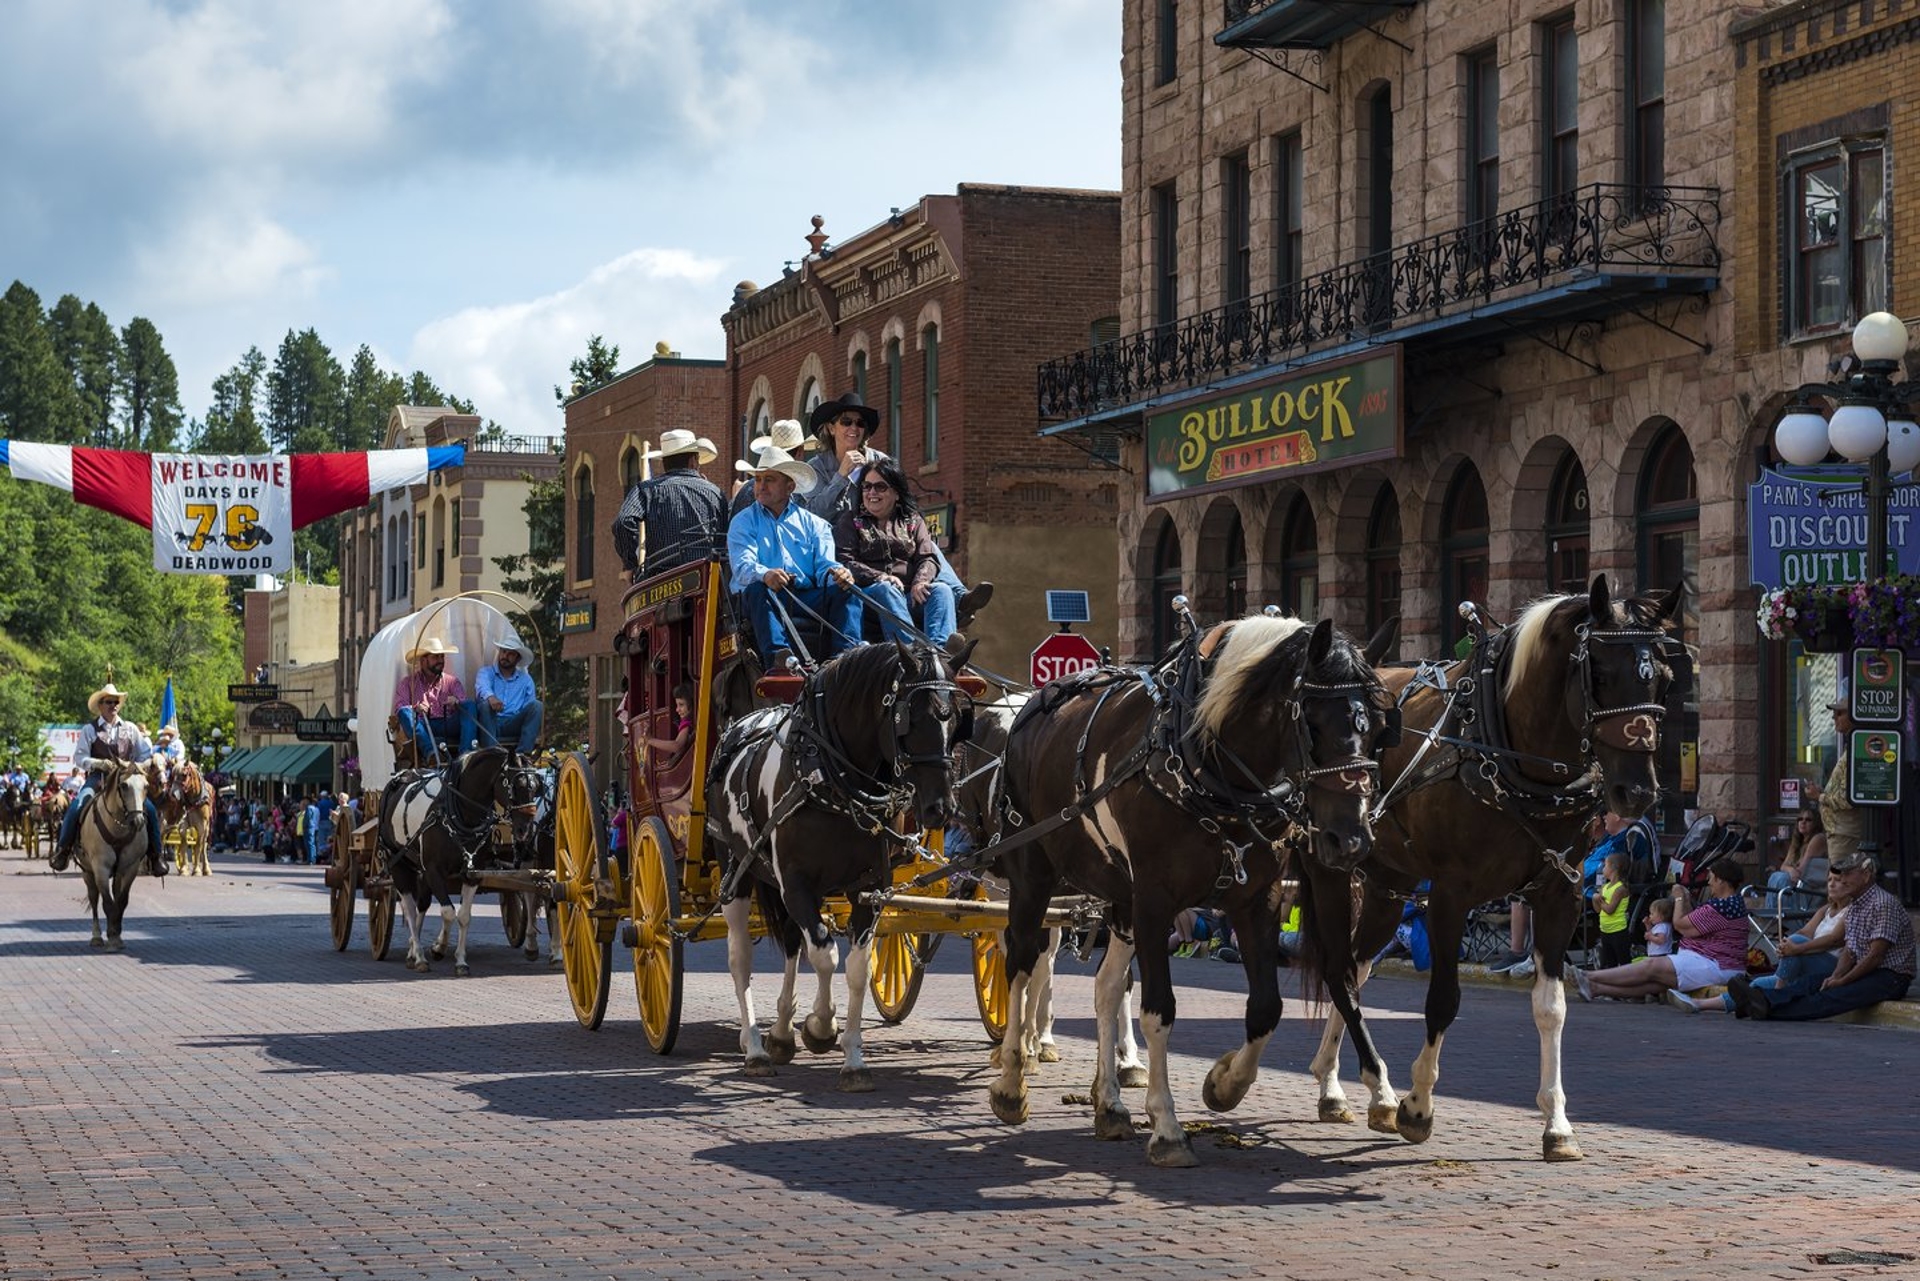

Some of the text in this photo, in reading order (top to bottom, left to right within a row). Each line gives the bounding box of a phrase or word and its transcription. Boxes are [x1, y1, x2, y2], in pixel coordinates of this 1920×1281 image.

[1359, 389, 1388, 416] 1895
[1178, 376, 1356, 473] BULLOCK
[1223, 441, 1298, 471] HOTEL
[160, 461, 285, 488] WELCOME
[184, 486, 259, 499] DAYS OF
[1574, 489, 1587, 511] 6
[1763, 482, 1812, 507] PAM'S
[1886, 488, 1919, 508] OOR
[185, 503, 260, 552] 76
[1769, 515, 1911, 548] DISCOUT
[172, 556, 273, 569] DEADWOOD
[1783, 551, 1894, 586] OUTLE
[650, 578, 683, 603] EXPRESS
[1857, 704, 1898, 714] NO PARKING
[1860, 689, 1894, 704] STOP
